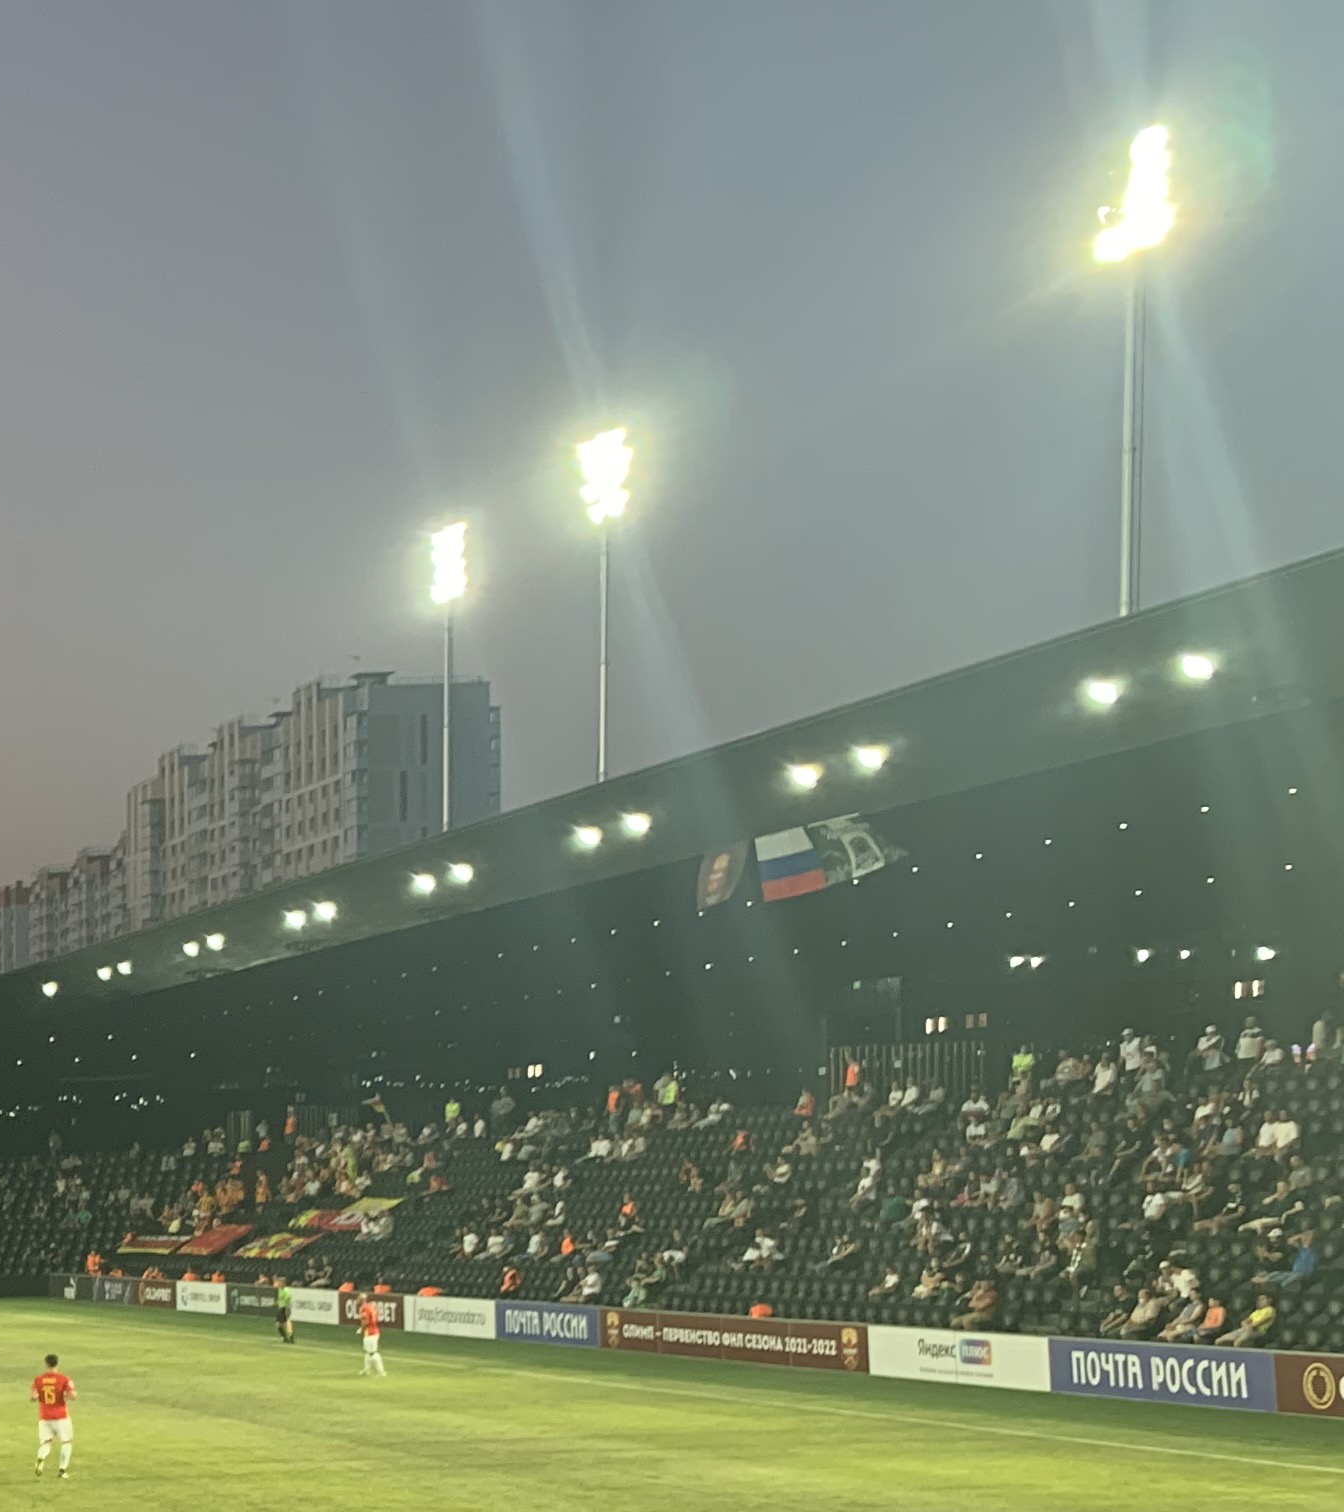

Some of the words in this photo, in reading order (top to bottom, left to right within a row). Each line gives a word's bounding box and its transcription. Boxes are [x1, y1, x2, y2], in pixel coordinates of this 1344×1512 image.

[345, 1298, 398, 1323] OLBET
[505, 1309, 540, 1335] ПОЧТА
[542, 1311, 588, 1340] РОССИИ
[662, 1327, 720, 1346] ПЕРВЕНСТВО
[744, 1334, 784, 1351] СЕЗОНА
[784, 1336, 837, 1356] 2021-2022
[917, 1338, 957, 1359] Яндекс
[1071, 1350, 1144, 1389] ПОЧТА
[1150, 1356, 1249, 1399] РОССИИ
